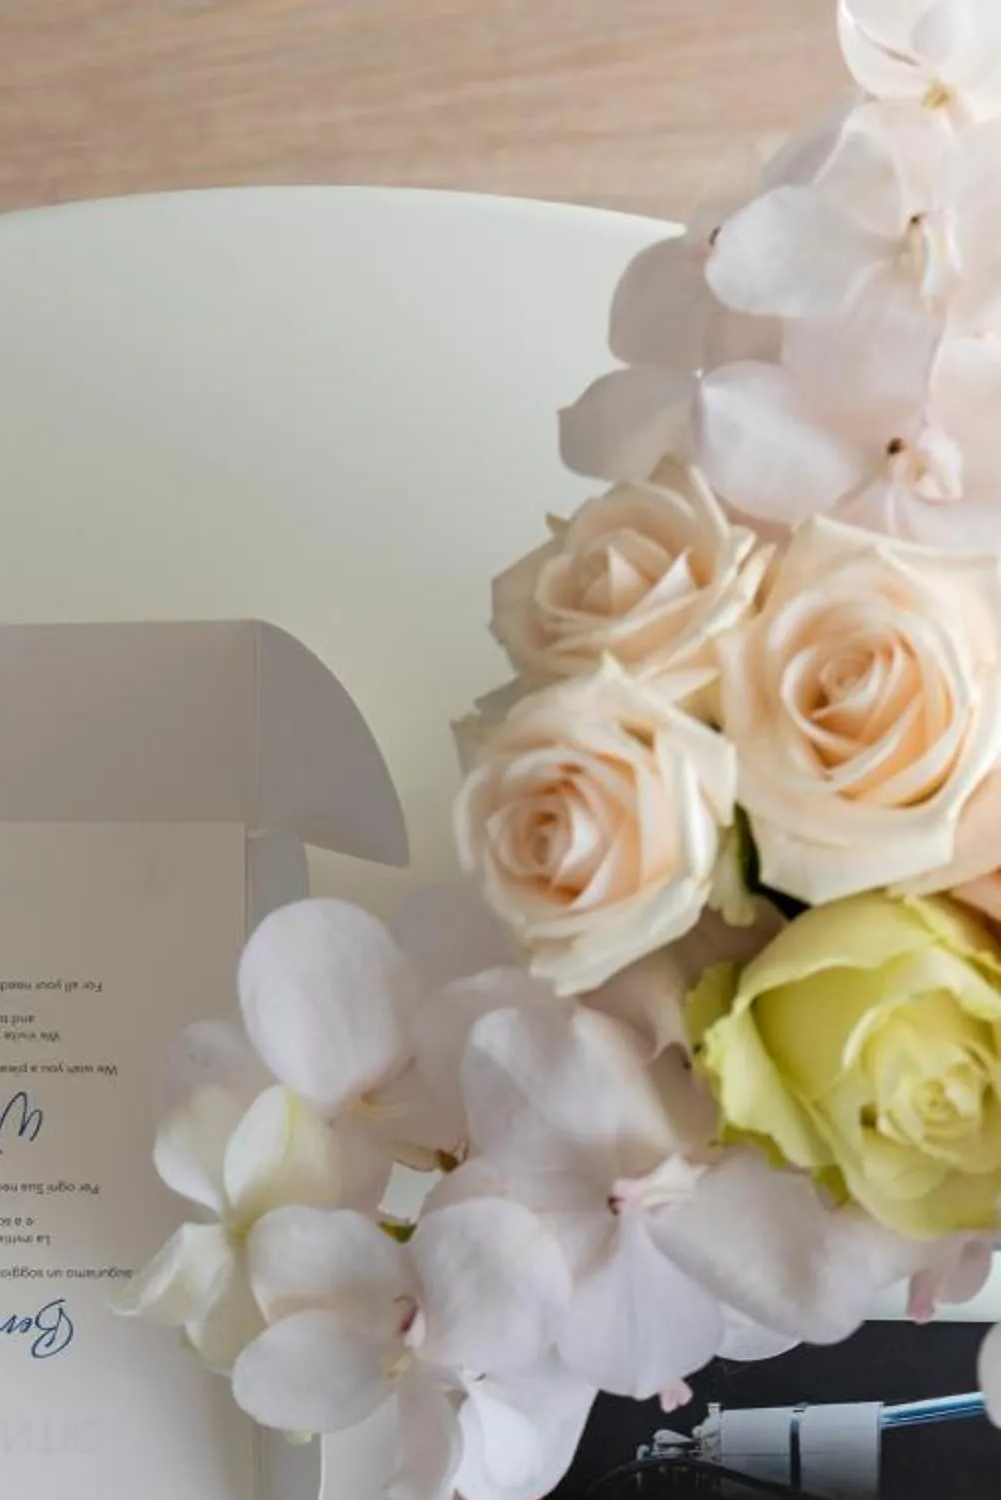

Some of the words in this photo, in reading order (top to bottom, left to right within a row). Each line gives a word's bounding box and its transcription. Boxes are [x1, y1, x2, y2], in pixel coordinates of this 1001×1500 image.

[35, 980, 62, 990] your
[64, 981, 79, 992] all
[81, 981, 102, 993] For
[10, 1015, 34, 1026] and
[3, 1032, 37, 1041] invite
[40, 1031, 60, 1043] We
[30, 1065, 38, 1073] a
[40, 1062, 64, 1073] you
[65, 1065, 93, 1074] wish
[97, 1065, 118, 1076] We
[20, 1183, 44, 1195] Sua
[46, 1180, 76, 1194] ogni
[78, 1183, 98, 1195] Per
[14, 1217, 24, 1228] a
[25, 1217, 33, 1226] e
[36, 1235, 51, 1246] La
[46, 1269, 64, 1278] un
